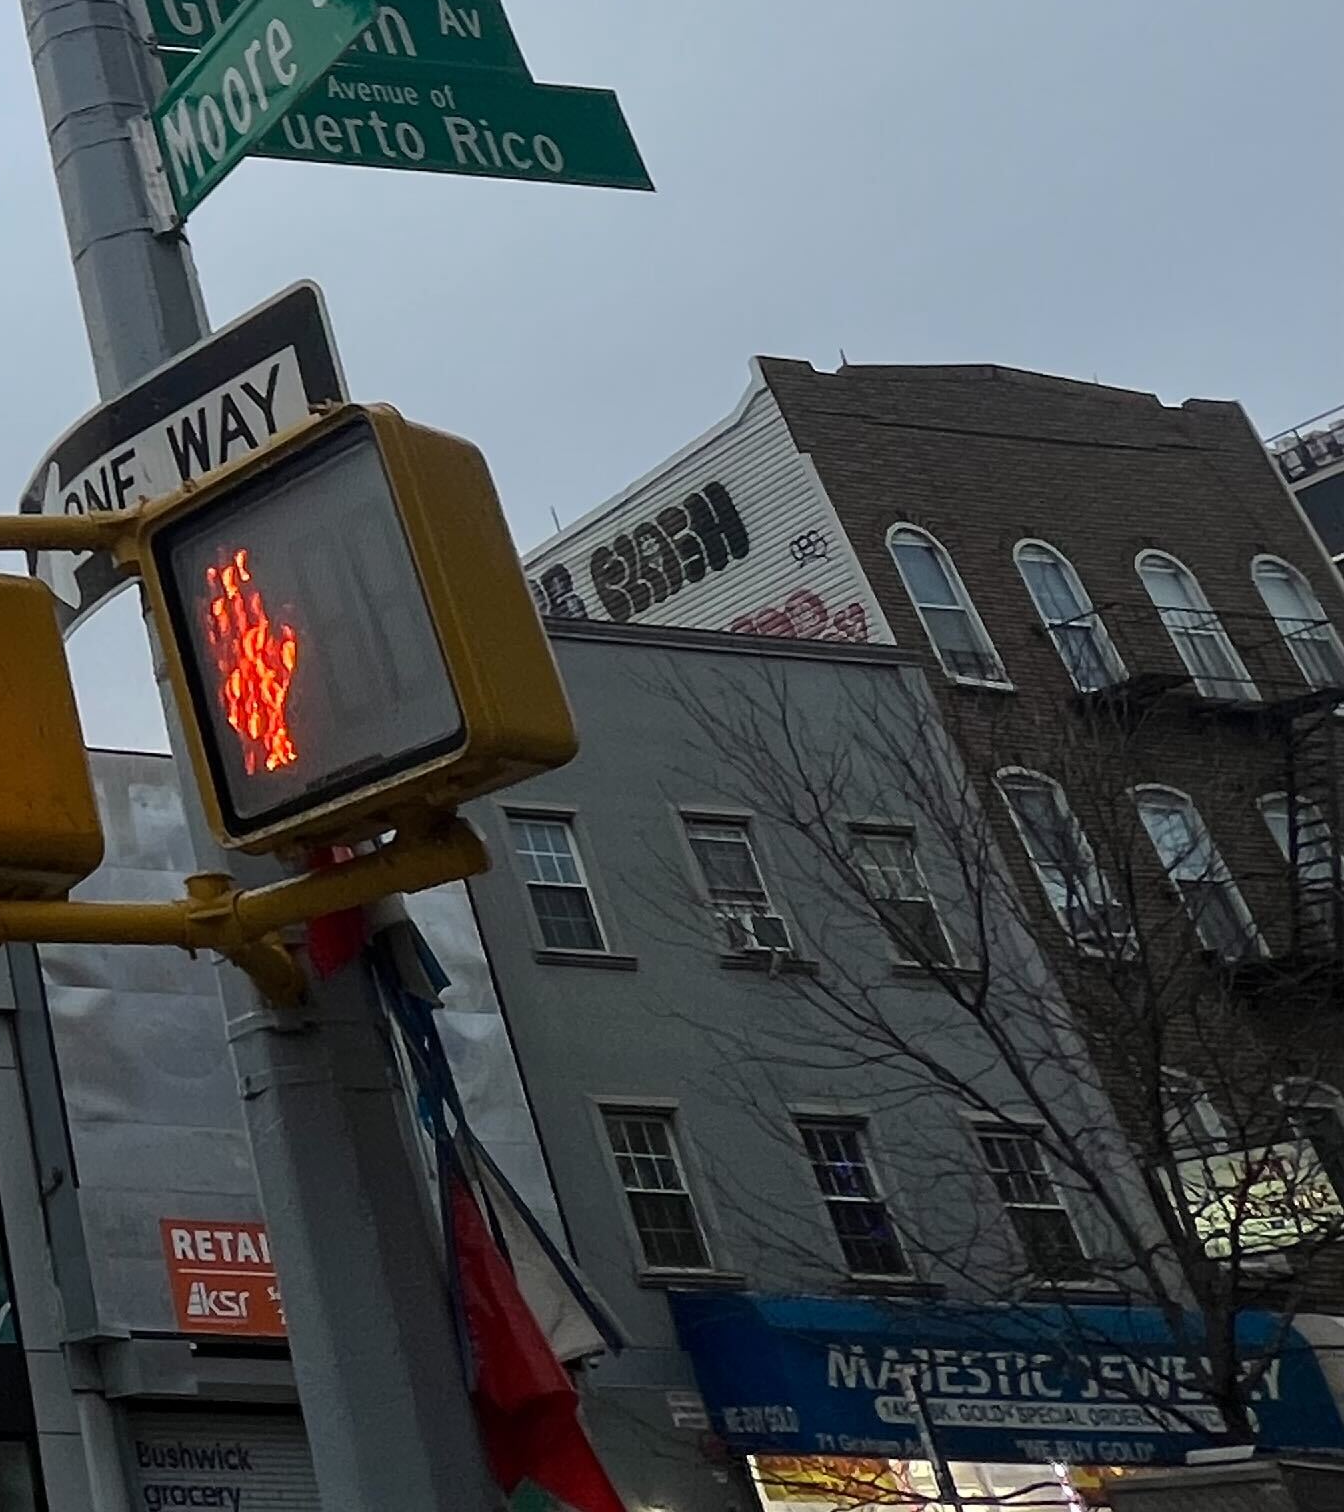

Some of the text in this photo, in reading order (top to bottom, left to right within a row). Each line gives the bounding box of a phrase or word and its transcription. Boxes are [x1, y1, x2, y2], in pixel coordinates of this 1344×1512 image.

[161, 17, 298, 197] Moore
[327, 74, 456, 110] Avenue of
[280, 109, 564, 173] uerto Rico
[166, 363, 282, 483] WAY
[171, 1228, 272, 1264] RETAI
[828, 1344, 1062, 1398] MAJESTIC
[1015, 1405, 1088, 1425] SPECIAL
[135, 1440, 254, 1471] Bushwick
[143, 1484, 241, 1512] grocery
